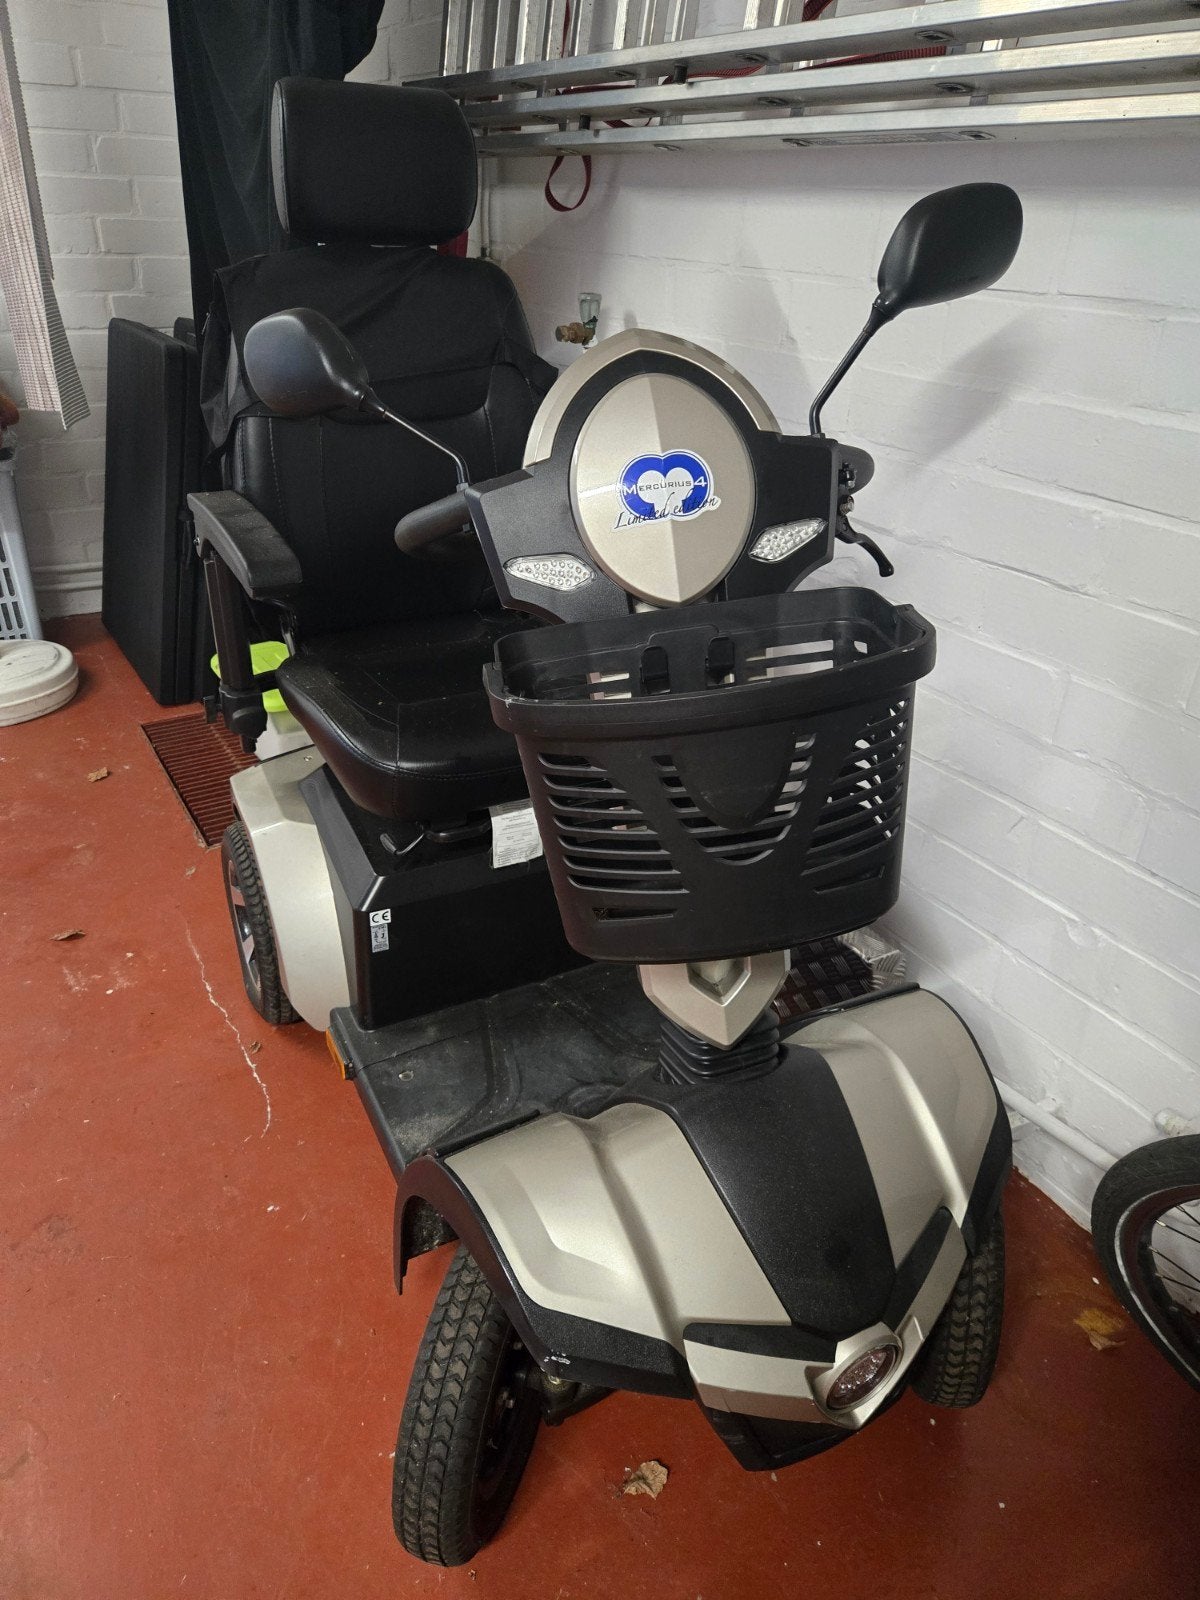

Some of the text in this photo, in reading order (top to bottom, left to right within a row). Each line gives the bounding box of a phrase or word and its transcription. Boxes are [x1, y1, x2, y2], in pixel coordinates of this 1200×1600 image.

[614, 488, 718, 529] Limited edition
[371, 910, 390, 924] CE
